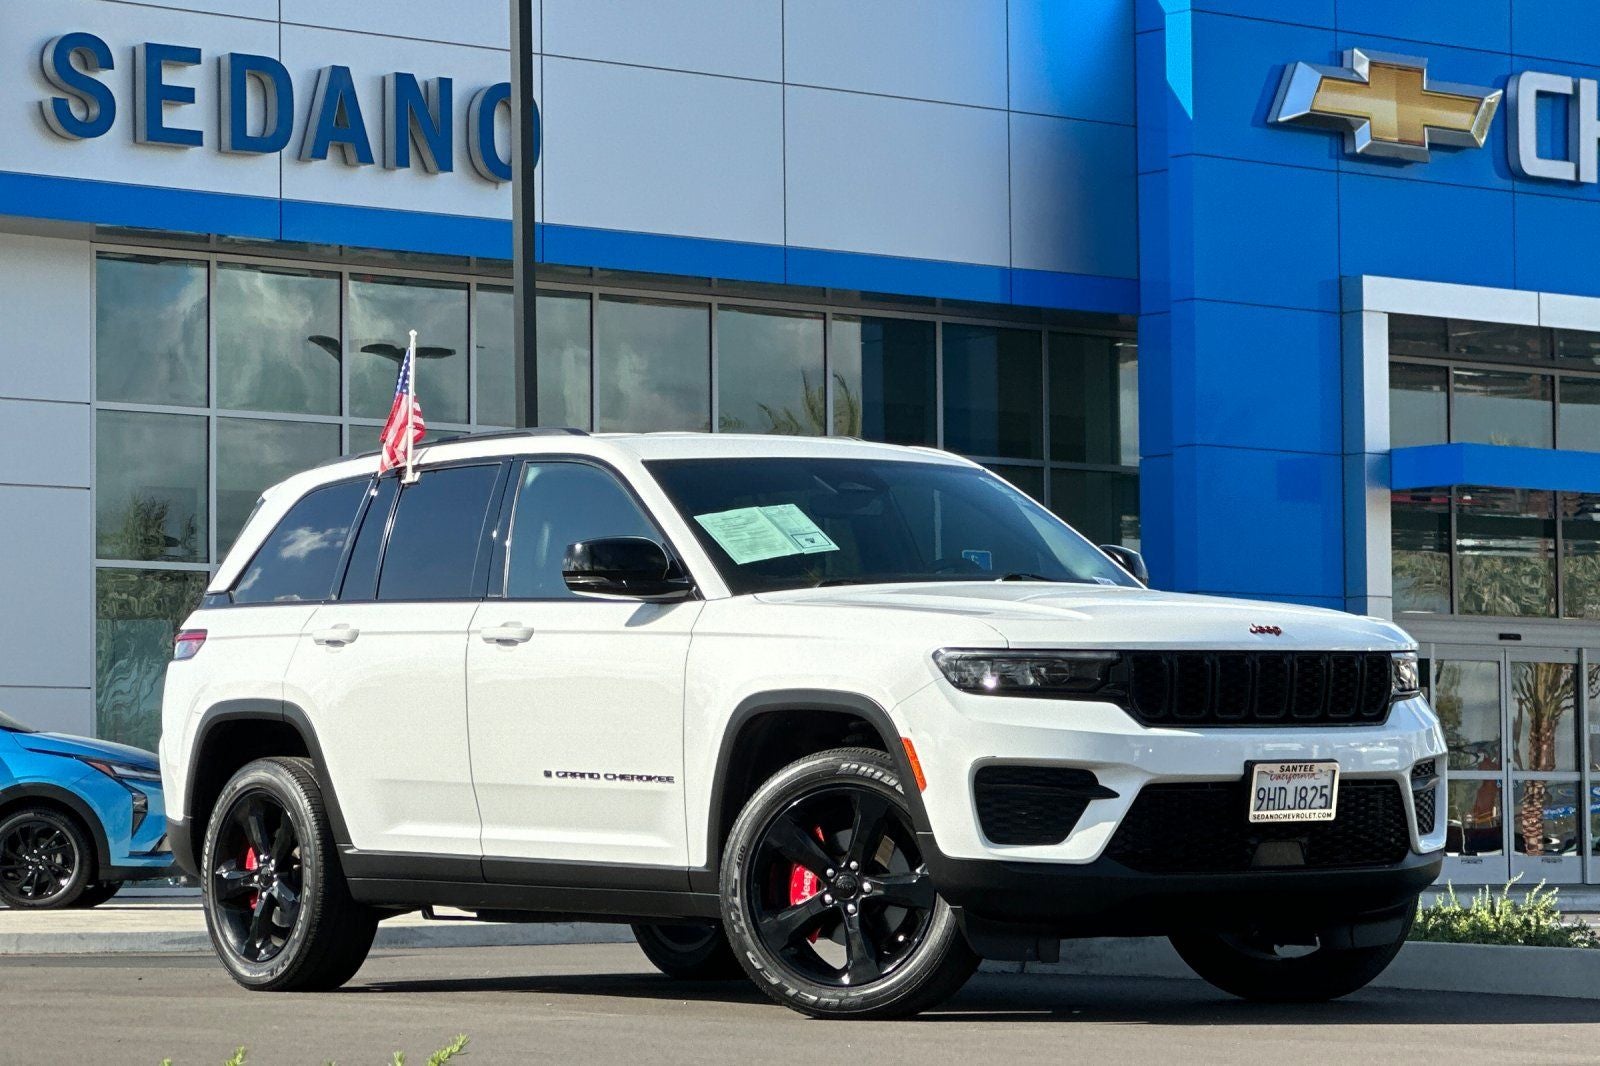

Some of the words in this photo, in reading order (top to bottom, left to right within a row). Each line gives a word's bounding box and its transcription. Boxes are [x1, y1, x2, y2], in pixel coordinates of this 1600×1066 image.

[41, 32, 541, 184] SEDANO
[555, 771, 601, 780] GRAND
[603, 773, 675, 783] CHEROKEE
[1279, 764, 1315, 773] SANTEE
[1255, 785, 1329, 811] 9HDJ825
[1252, 812, 1332, 820] SEDANOCHEVROLET.COM
[801, 870, 813, 899] Jeep
